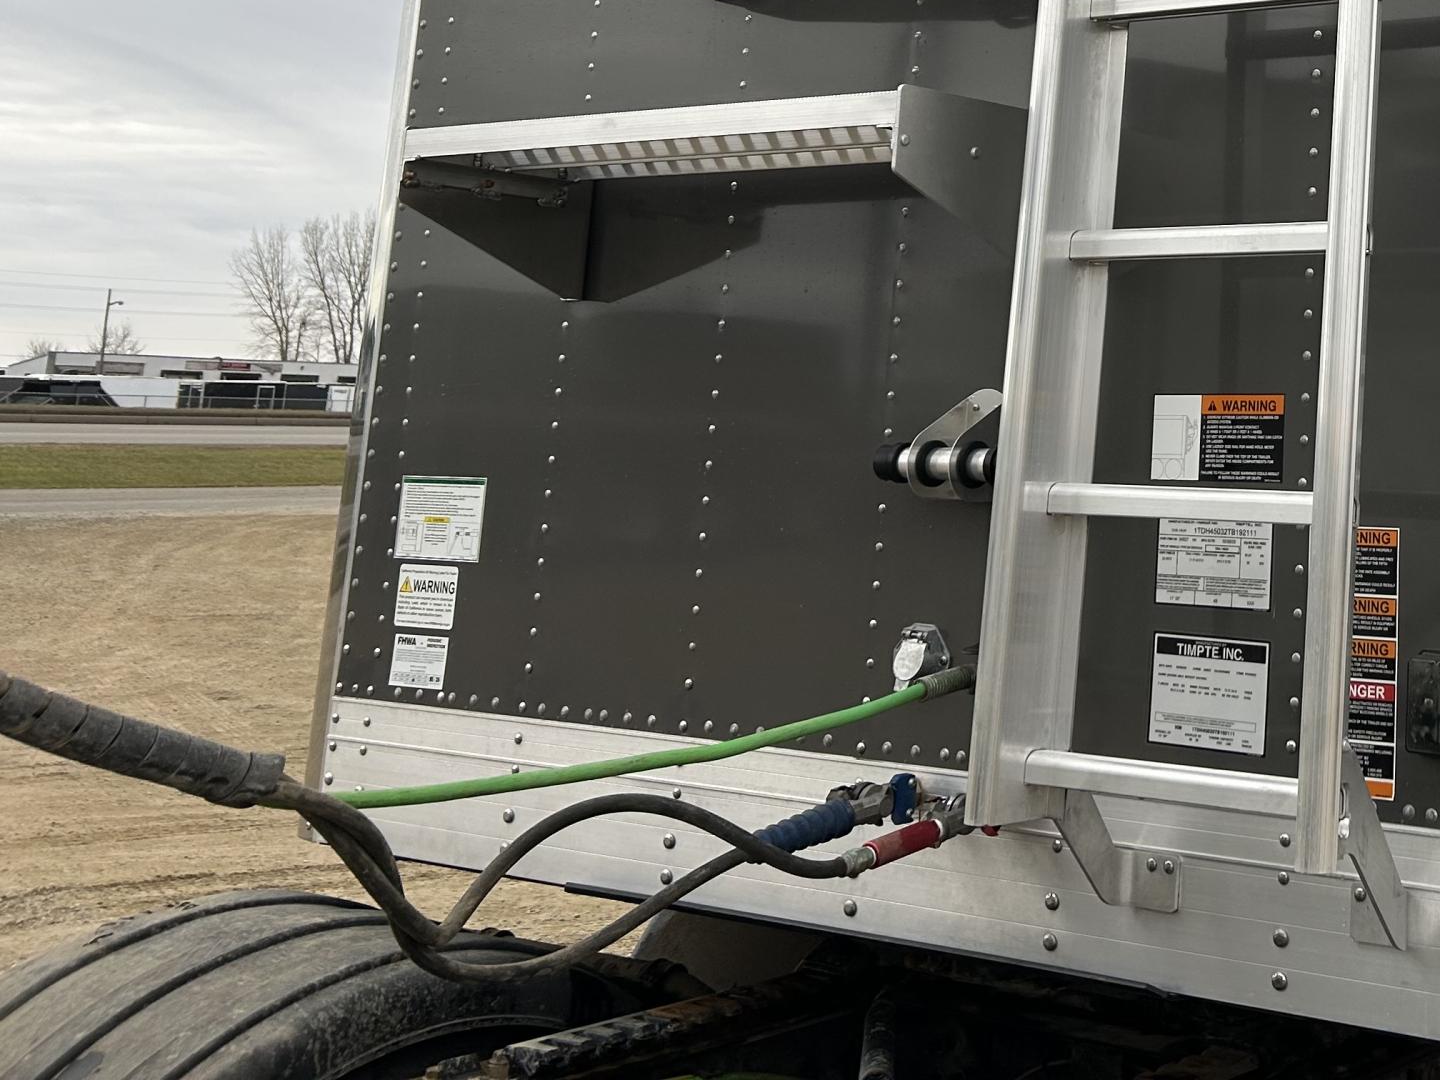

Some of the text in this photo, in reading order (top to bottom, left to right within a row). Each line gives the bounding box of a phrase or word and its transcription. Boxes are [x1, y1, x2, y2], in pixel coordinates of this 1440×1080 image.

[1221, 400, 1277, 412] WARNING
[1356, 531, 1391, 545] NING
[413, 579, 455, 595] WARNING
[1353, 600, 1389, 614] RNING
[397, 636, 417, 646] FHWA
[1222, 647, 1245, 661] INC.
[1352, 642, 1389, 656] RNING
[1349, 683, 1385, 699] NGER
